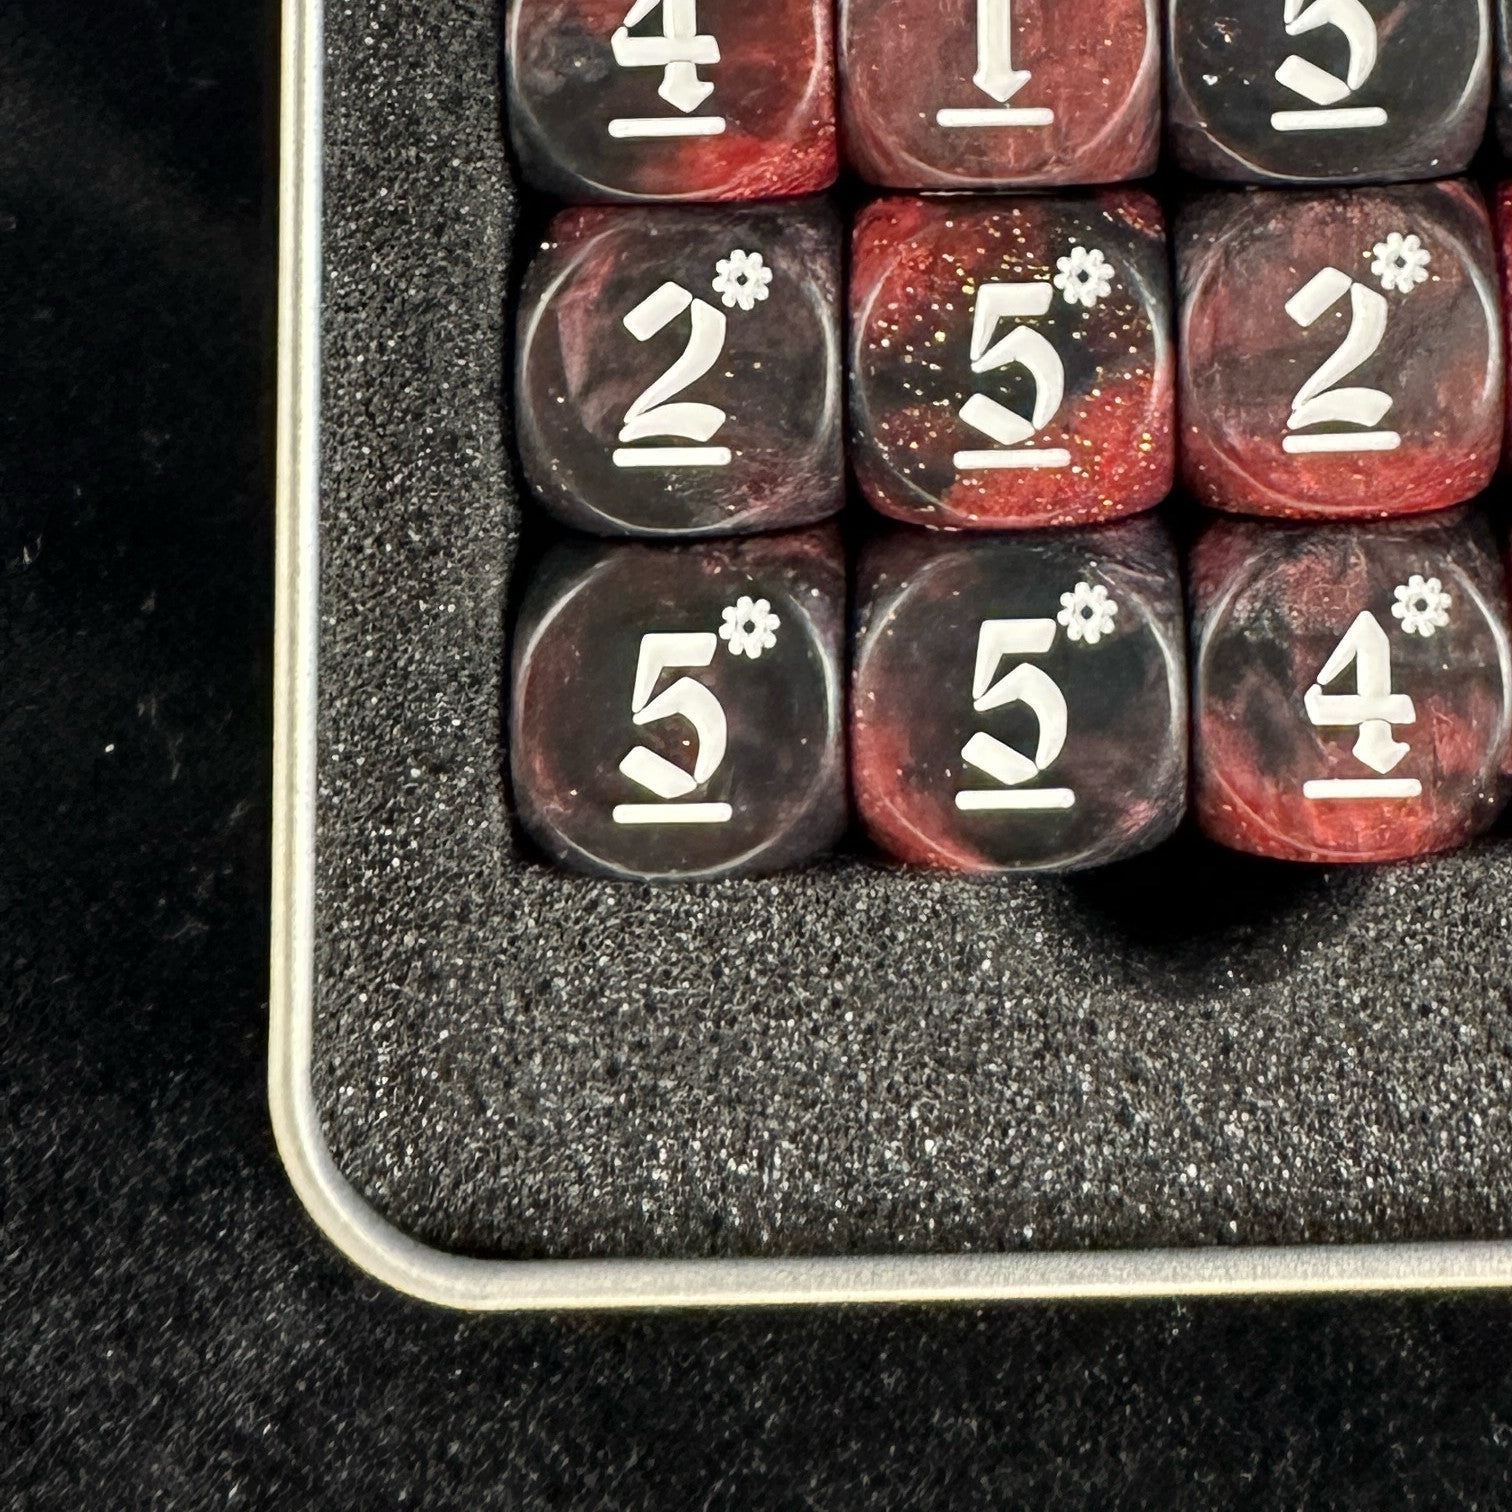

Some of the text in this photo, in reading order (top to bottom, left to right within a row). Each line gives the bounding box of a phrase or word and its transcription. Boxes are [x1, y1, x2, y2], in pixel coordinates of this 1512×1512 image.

[619, 282, 726, 442] 2
[959, 283, 1064, 445] 5
[1285, 267, 1393, 429] 2
[620, 633, 727, 798] 5
[961, 619, 1068, 785] 5
[1304, 611, 1416, 774] 4
